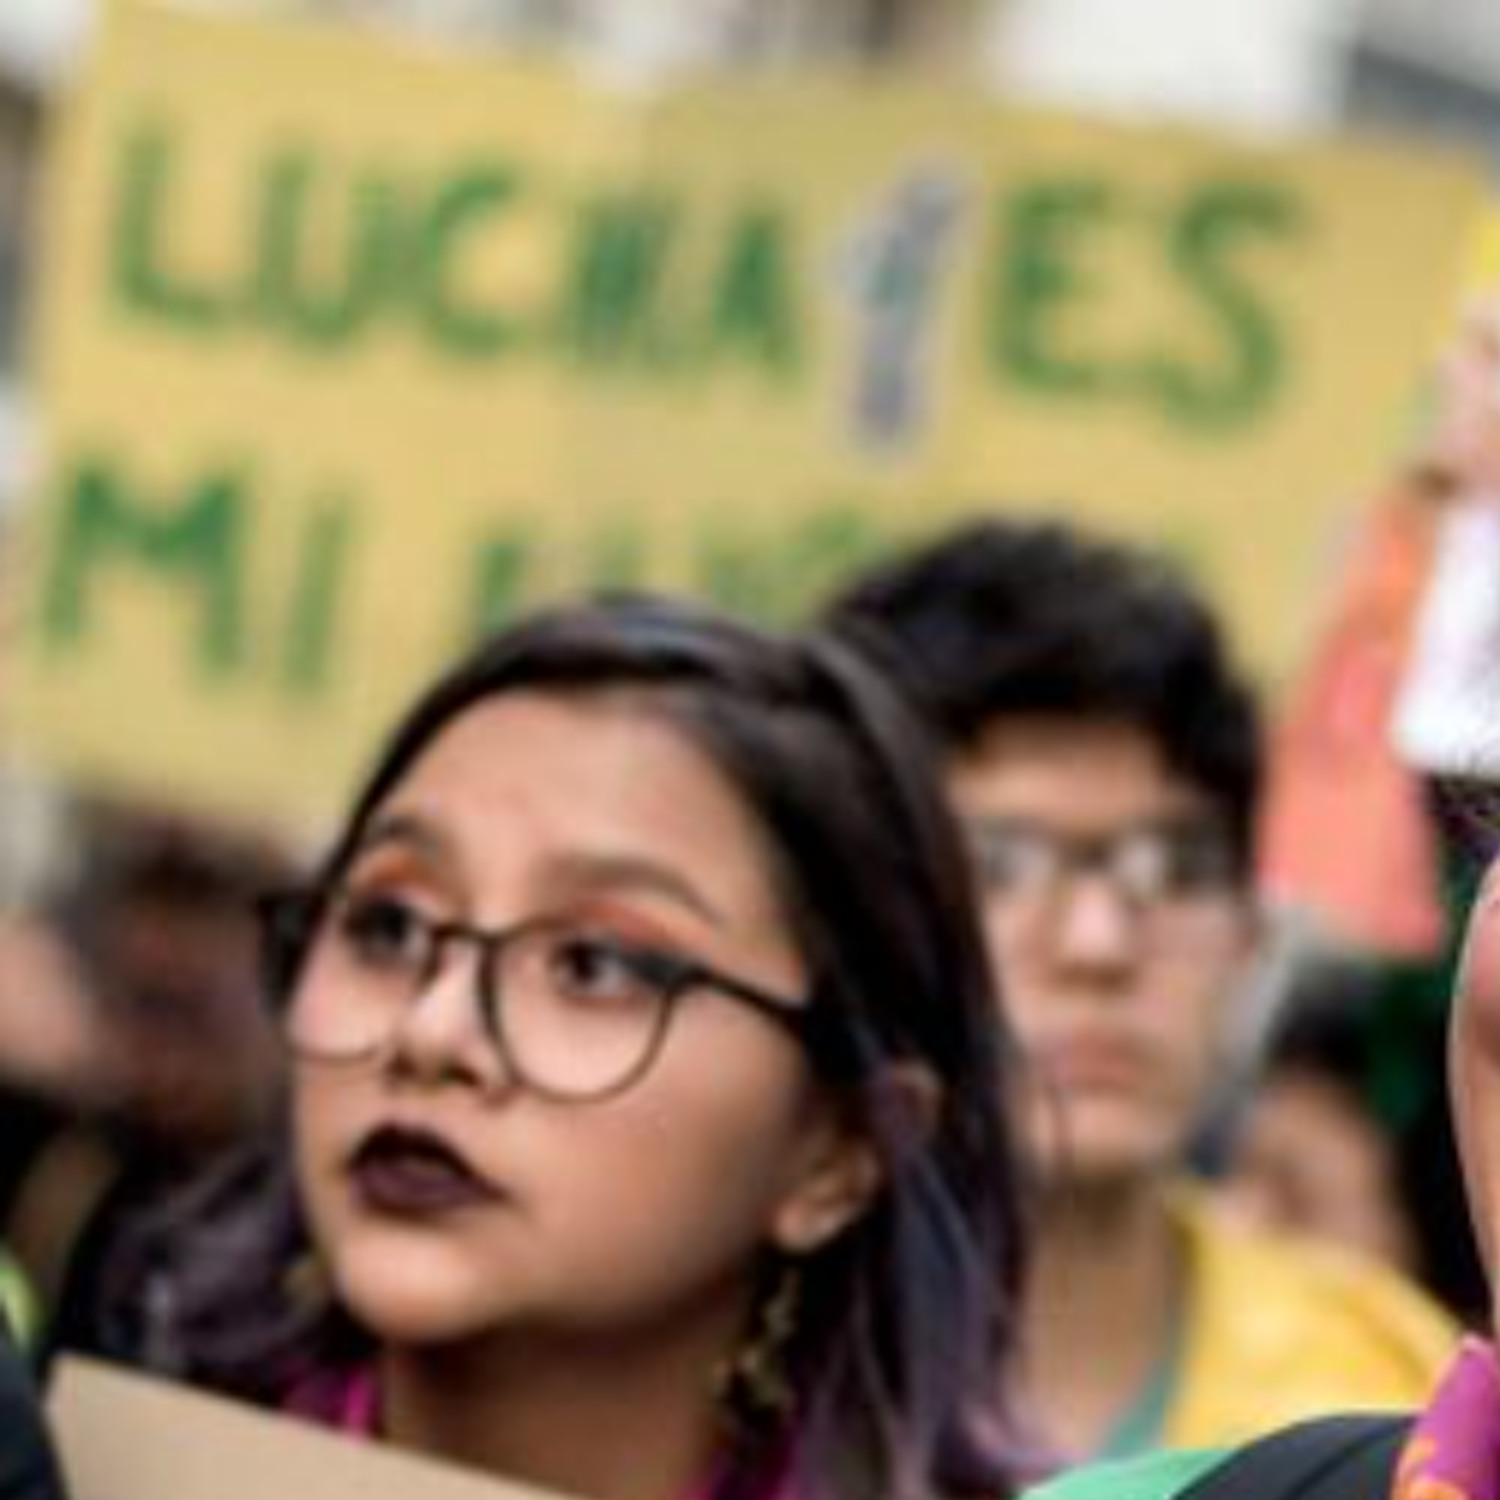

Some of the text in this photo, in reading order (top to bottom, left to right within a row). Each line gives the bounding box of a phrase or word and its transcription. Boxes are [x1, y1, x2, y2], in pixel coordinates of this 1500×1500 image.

[110, 115, 1312, 438] LUCHA ES
[38, 455, 355, 698] MI
